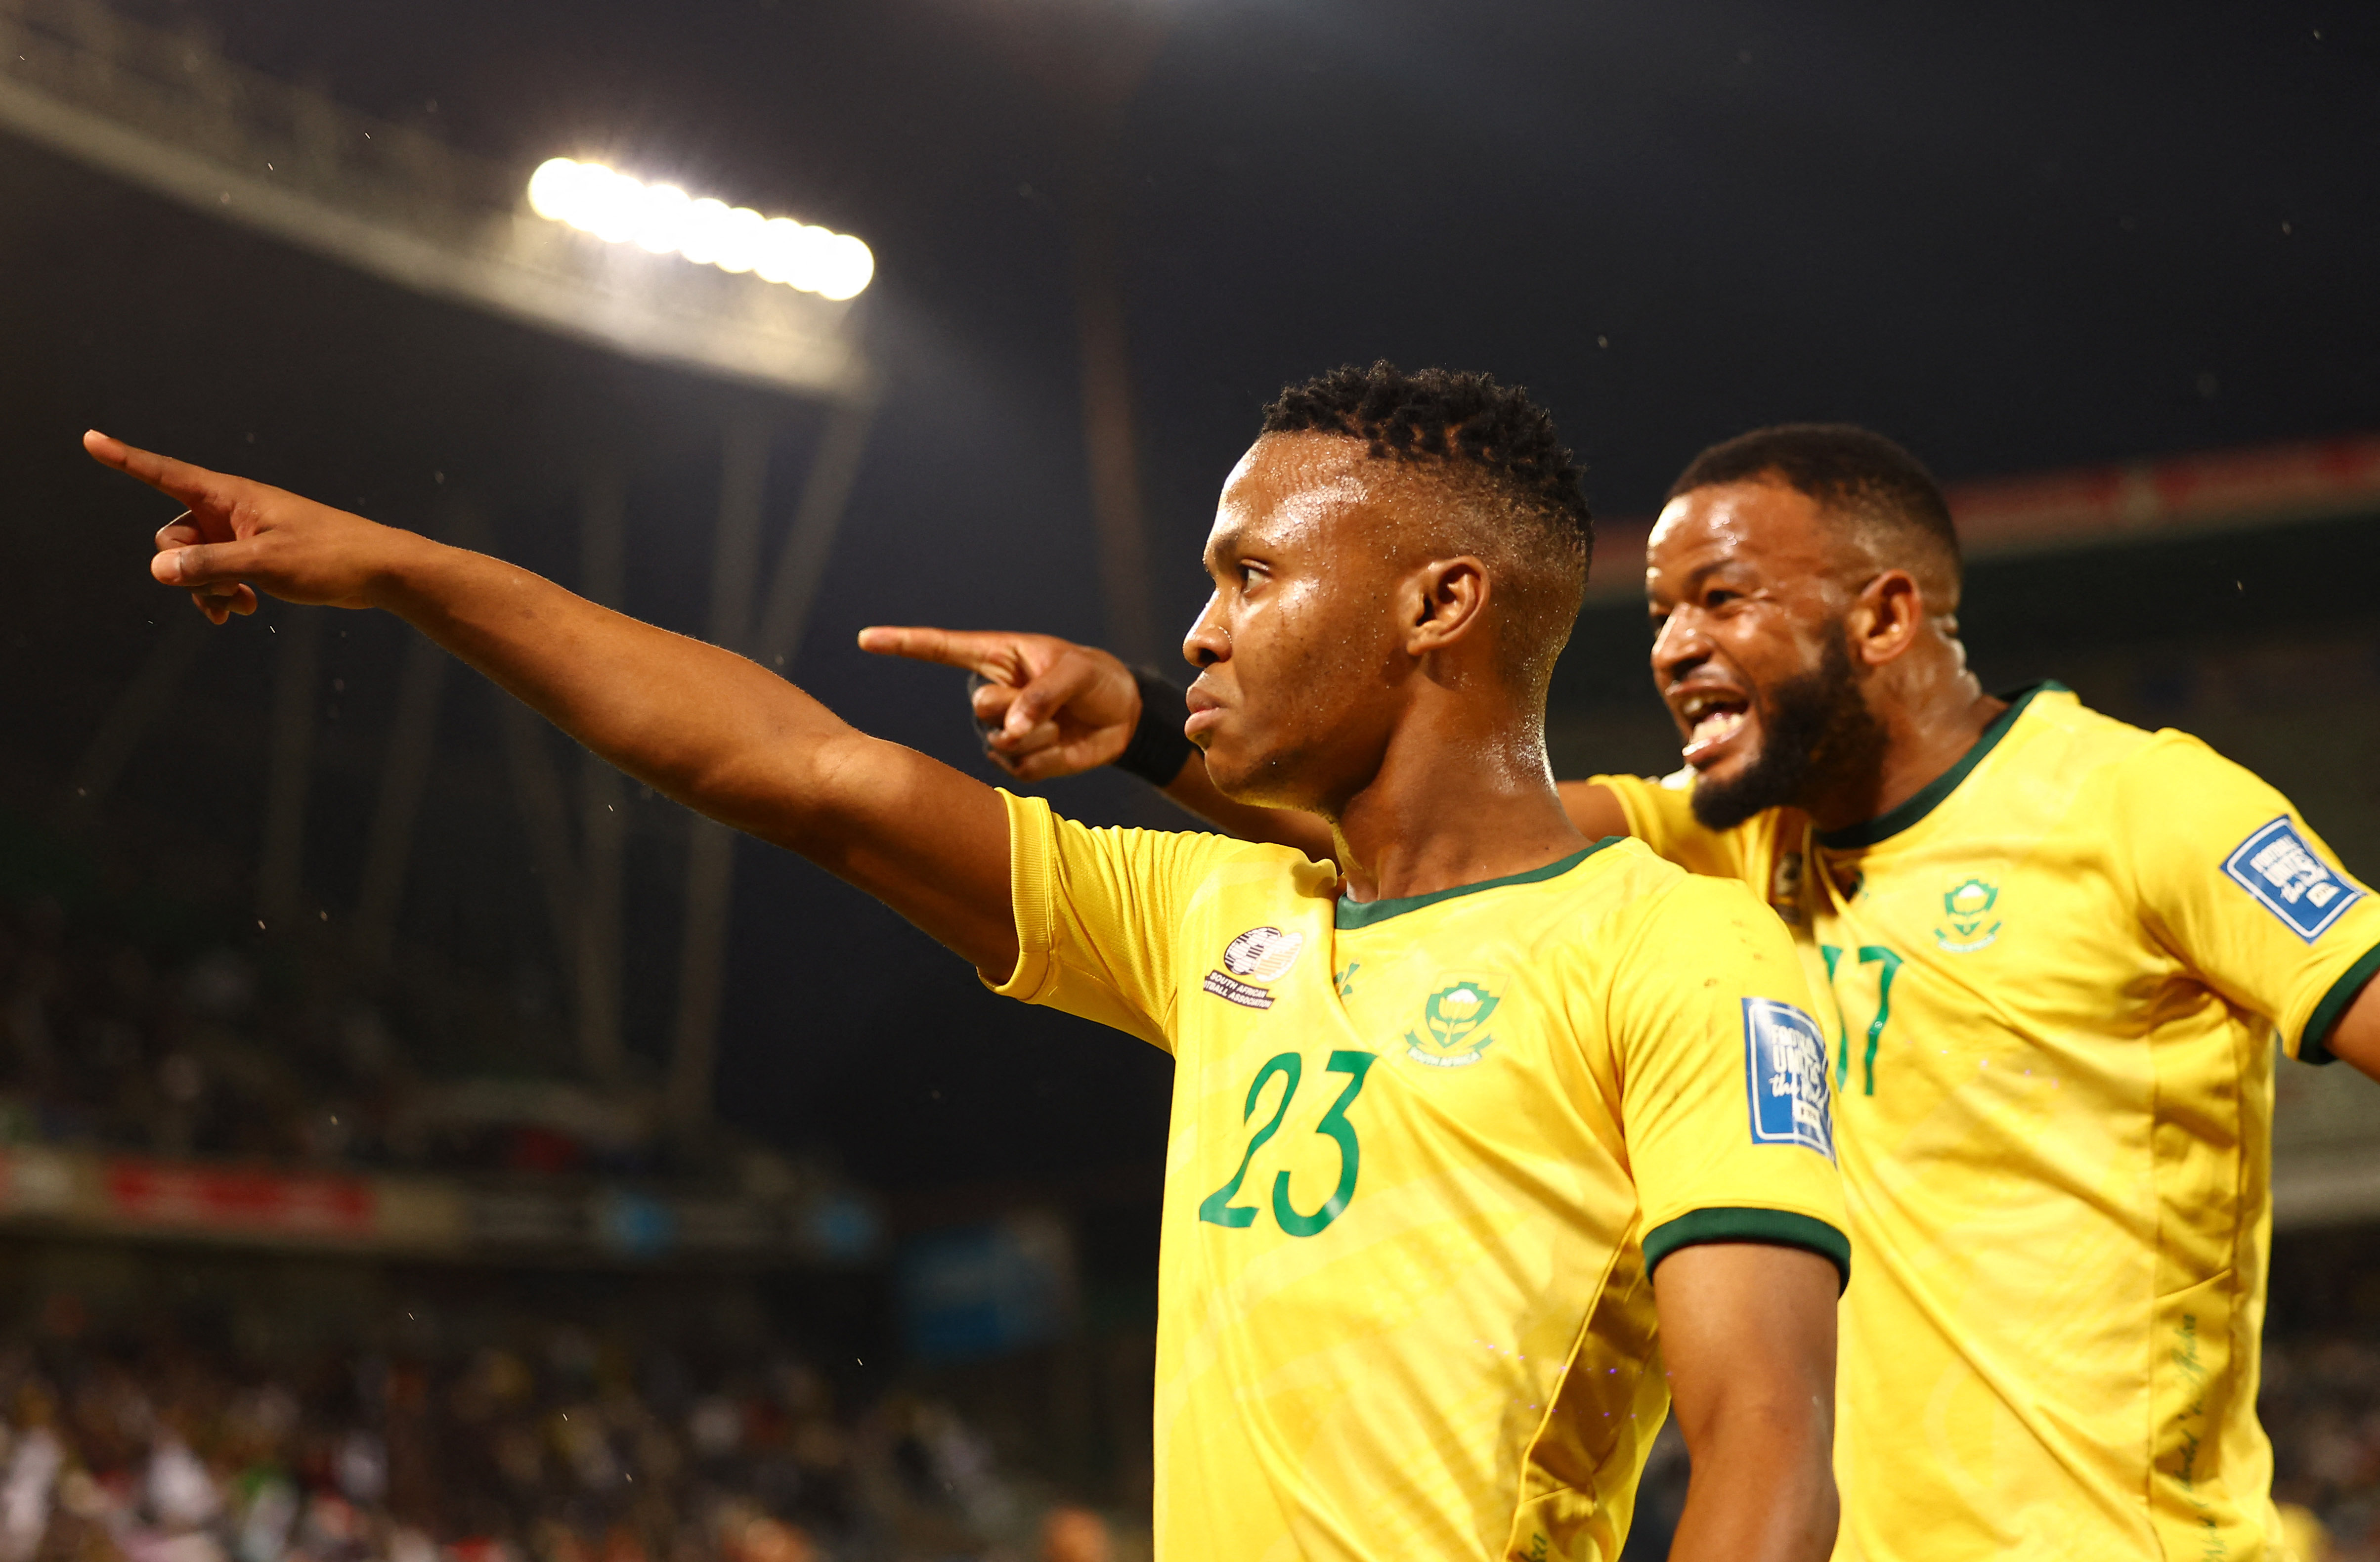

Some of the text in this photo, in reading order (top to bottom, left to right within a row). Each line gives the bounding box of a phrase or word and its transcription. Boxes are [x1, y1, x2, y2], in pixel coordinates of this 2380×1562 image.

[1204, 980, 1273, 1008] OTBALL ASSOCIATION
[1210, 972, 1267, 998] SOUTH AFRICAN
[1199, 1050, 1379, 1237] 23
